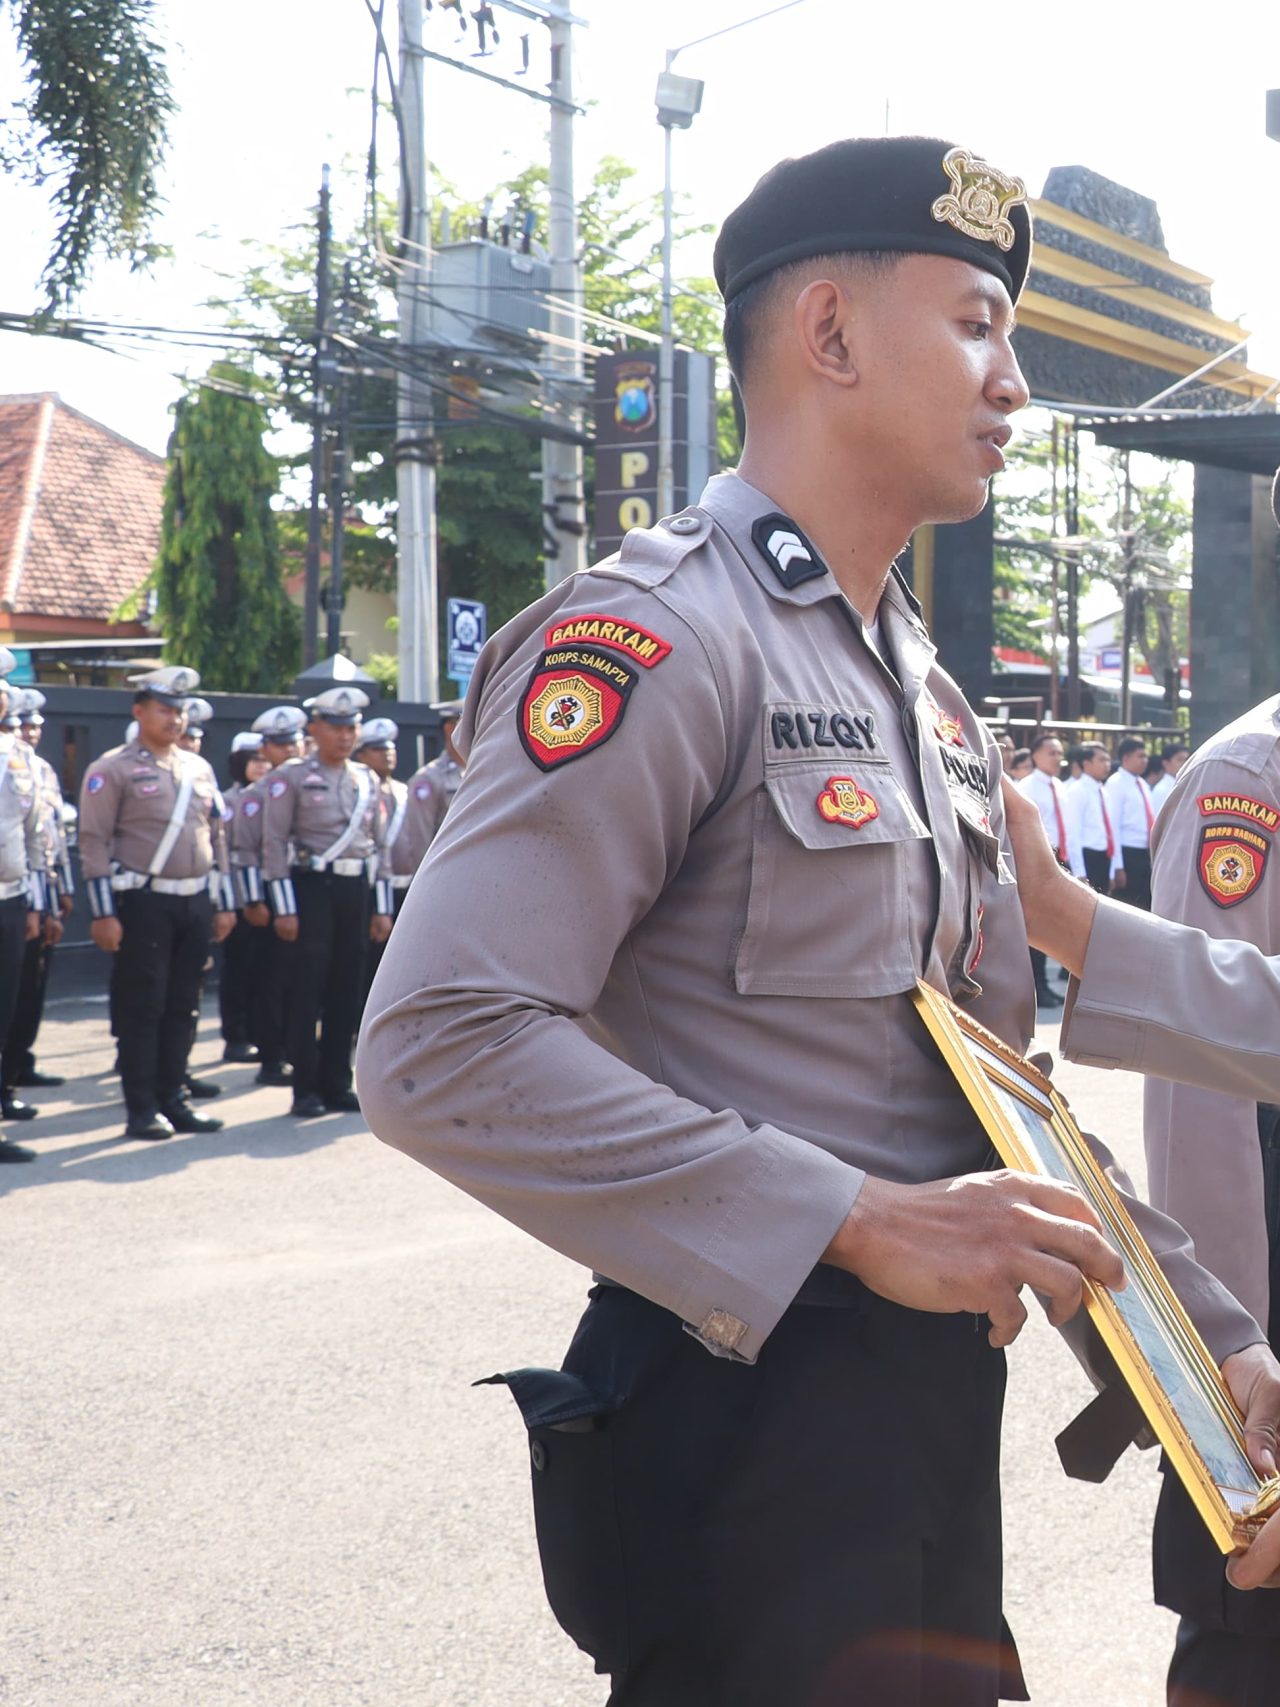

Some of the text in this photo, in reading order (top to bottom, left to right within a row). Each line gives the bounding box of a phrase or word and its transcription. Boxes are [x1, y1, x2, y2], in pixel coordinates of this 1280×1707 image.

[551, 620, 658, 659] BAHARKAM
[545, 651, 631, 687] KORPS SAMAPTA
[771, 711, 877, 750] RIZQY
[1203, 796, 1278, 826] BAHARKAM
